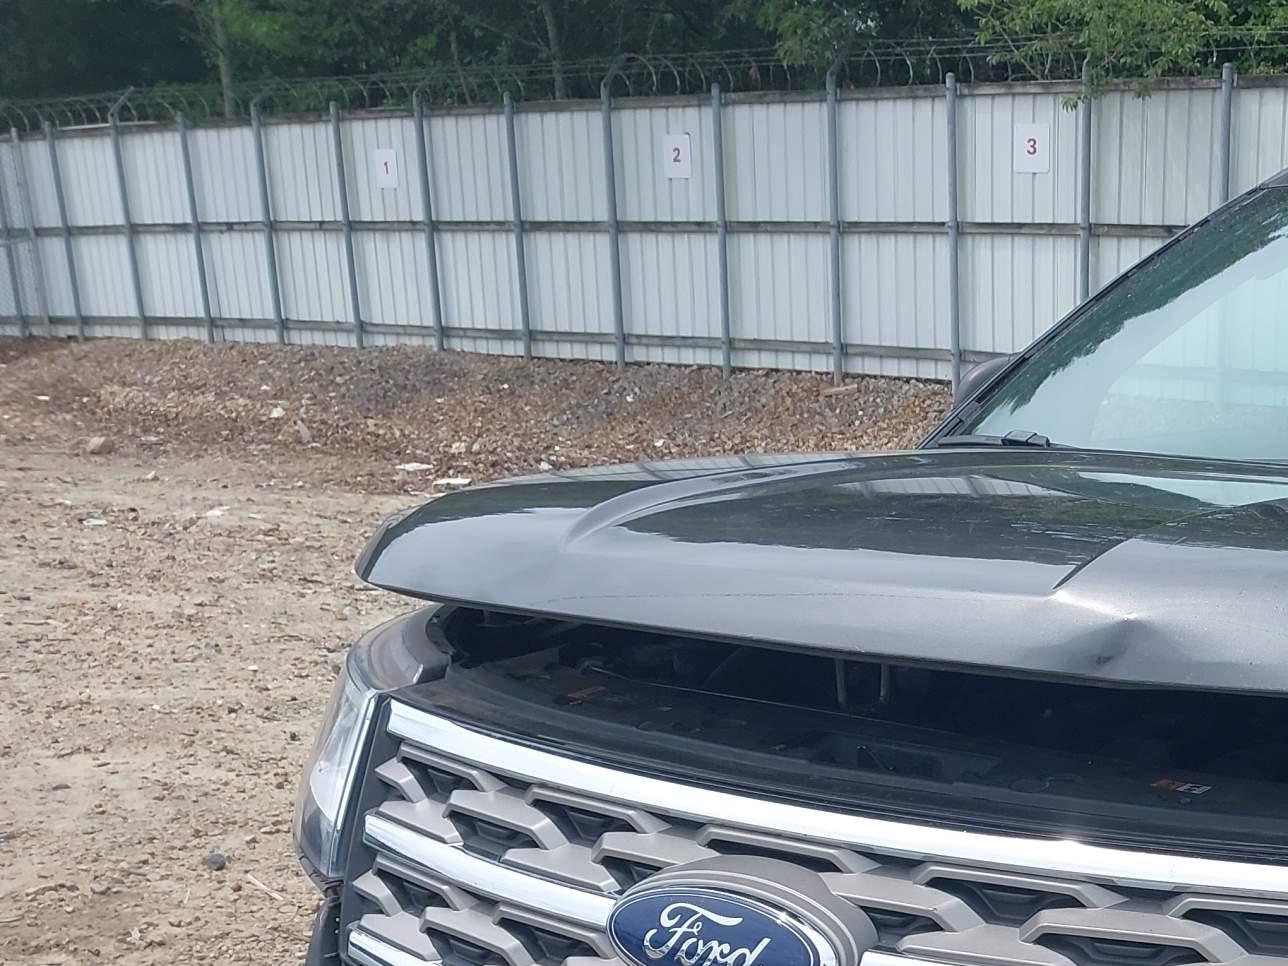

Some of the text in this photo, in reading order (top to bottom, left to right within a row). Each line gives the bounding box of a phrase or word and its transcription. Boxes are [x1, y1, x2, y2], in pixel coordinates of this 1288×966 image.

[1026, 138, 1037, 155] 3
[672, 147, 681, 163] 2
[383, 161, 389, 175] 1
